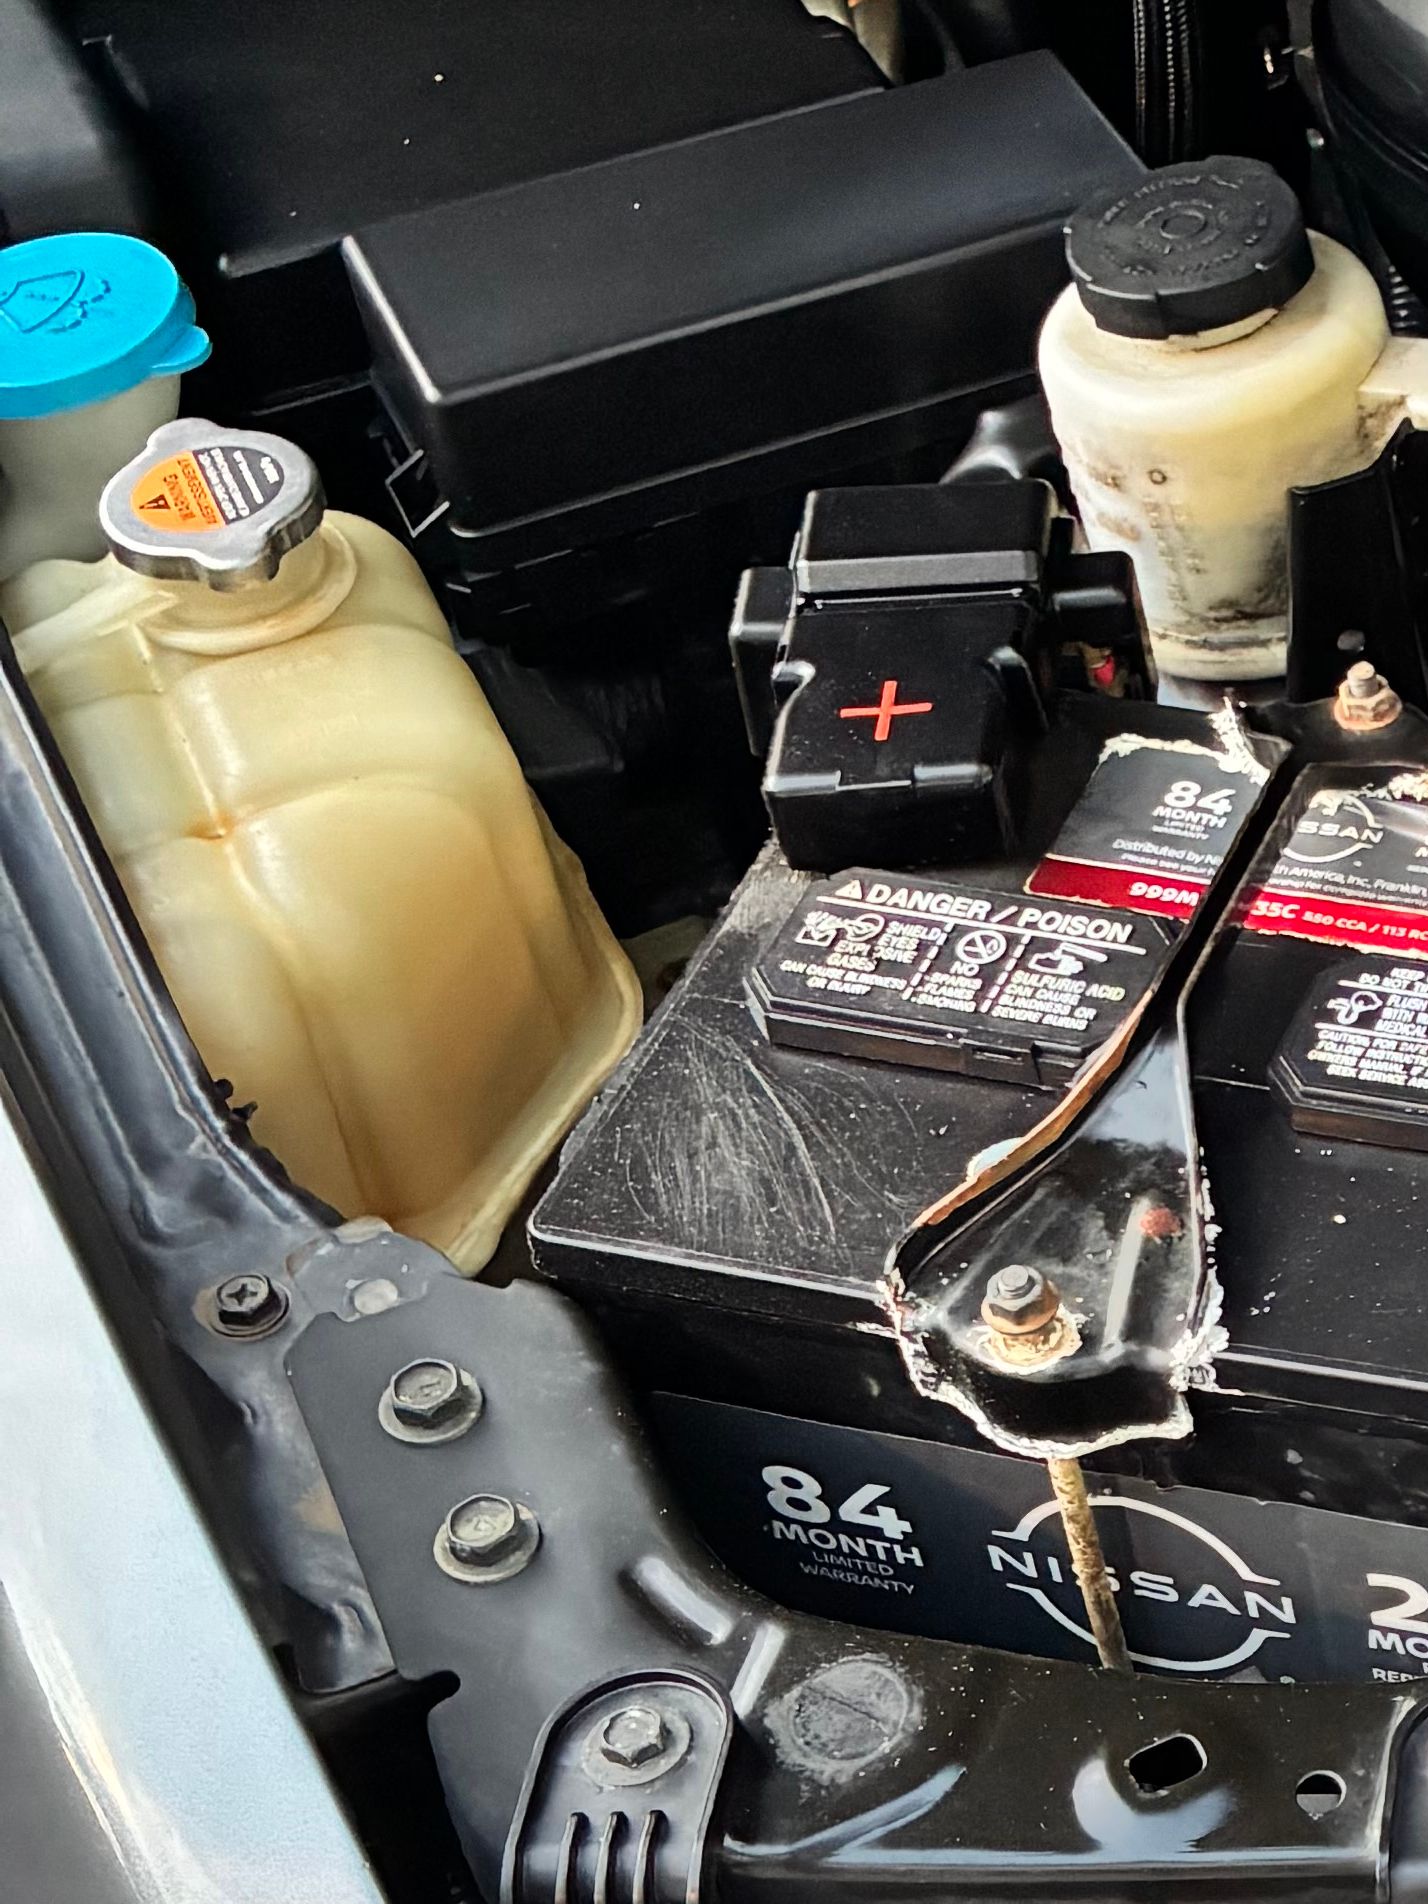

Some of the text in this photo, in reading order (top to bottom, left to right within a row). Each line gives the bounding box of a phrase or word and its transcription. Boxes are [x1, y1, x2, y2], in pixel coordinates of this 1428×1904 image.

[1164, 780, 1236, 816] 84
[1152, 805, 1228, 829] MONTH
[1296, 820, 1384, 844] SSAN
[1112, 838, 1186, 859] Distributed
[1186, 847, 1203, 864] by
[865, 883, 992, 920] DANGER
[1017, 908, 1133, 944] POISON
[1301, 910, 1335, 926] 550
[1334, 917, 1368, 932] CCA
[1381, 924, 1407, 938] 113
[877, 933, 921, 951] EYES
[886, 920, 942, 941] SHIELD
[779, 959, 807, 974] CAN
[806, 963, 845, 979] CAUSE
[825, 952, 878, 973] GASES
[950, 961, 980, 977] NO
[1390, 967, 1426, 982] KEEP
[806, 976, 827, 989] OR
[1010, 969, 1127, 1002] SULFURIC ACID
[1358, 972, 1381, 985] DO
[1381, 976, 1408, 990] NOT
[997, 993, 1097, 1021] BLINDNESS OR
[1003, 983, 1082, 1007] CAN CAUSE
[1385, 994, 1428, 1012] FLUSH
[991, 1003, 1089, 1032] SEVERE BURNS
[1380, 1006, 1415, 1022] WITH
[1315, 1039, 1366, 1057] FOLLOW
[1370, 1037, 1400, 1051] FOR
[760, 1464, 913, 1541] 84
[771, 1520, 925, 1570] MONTH
[811, 1549, 895, 1577] LIMITED
[798, 1560, 917, 1595] WARRANTY
